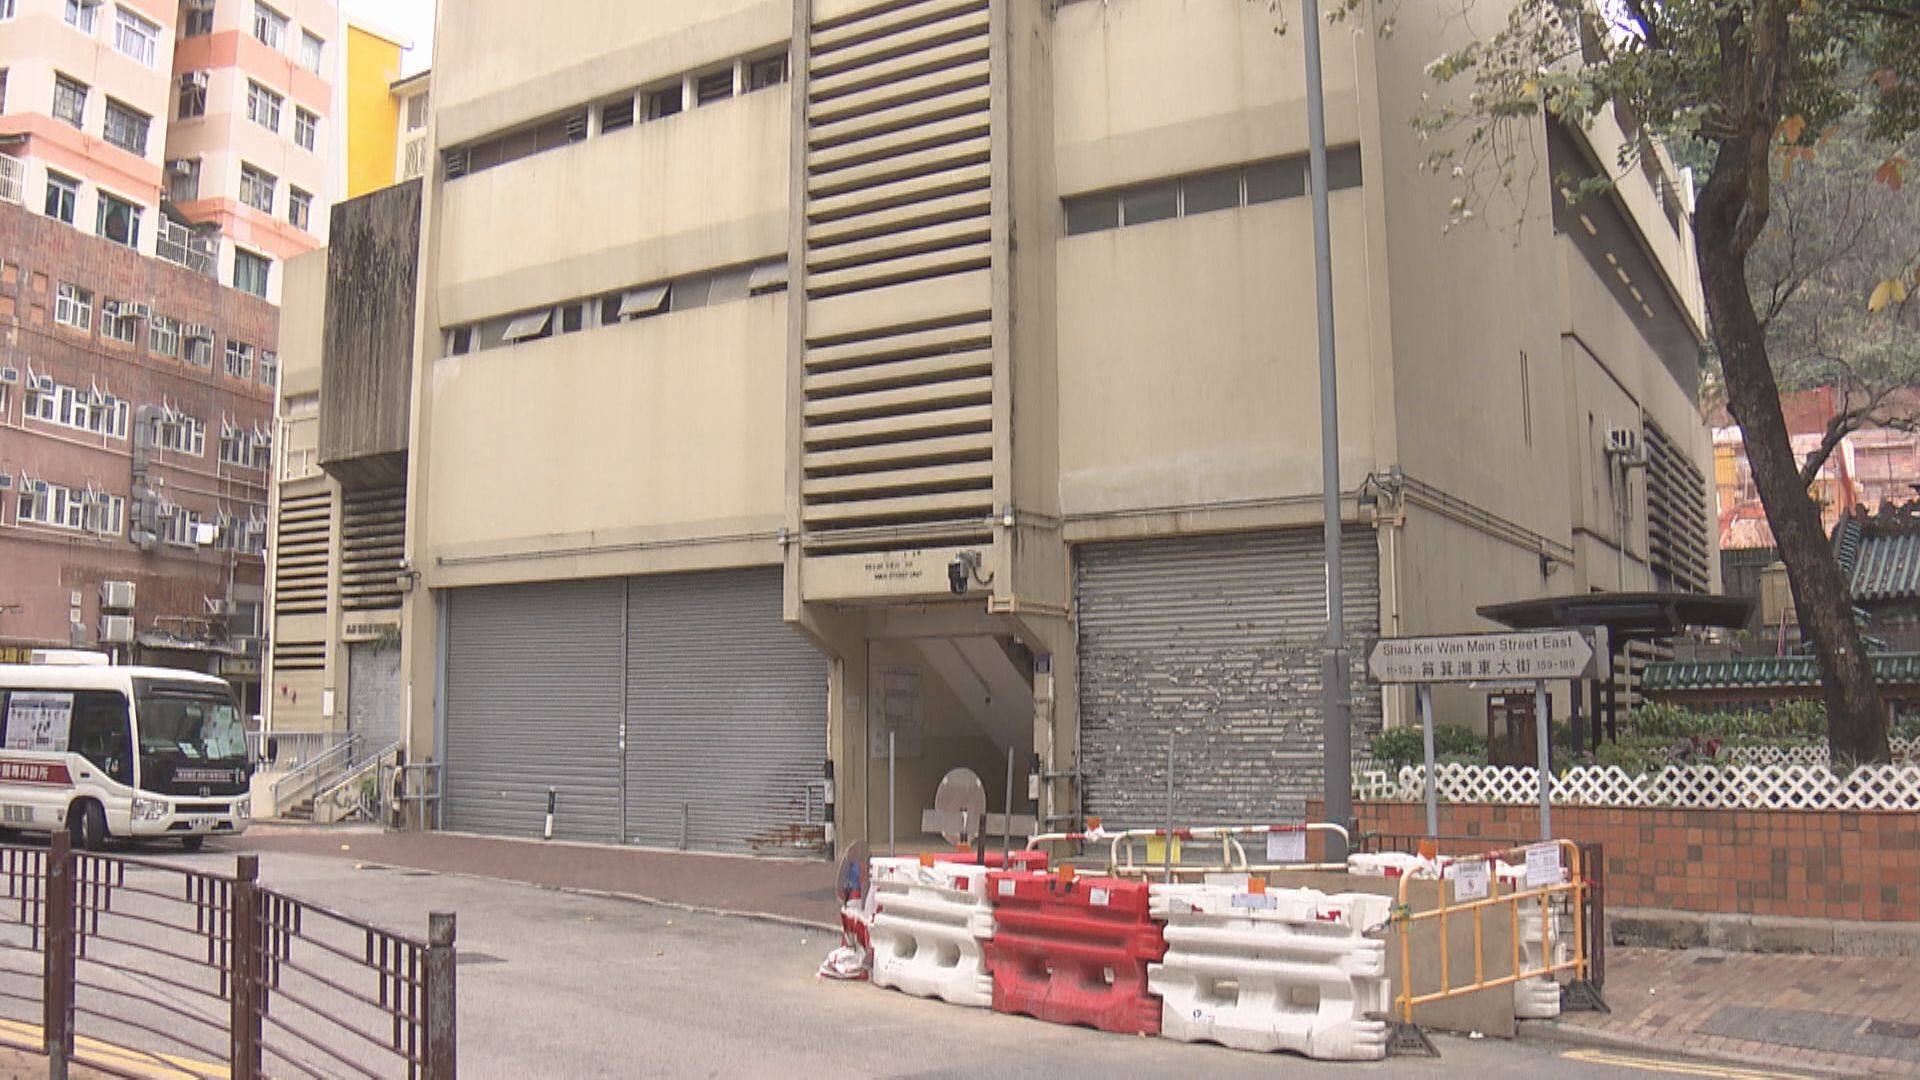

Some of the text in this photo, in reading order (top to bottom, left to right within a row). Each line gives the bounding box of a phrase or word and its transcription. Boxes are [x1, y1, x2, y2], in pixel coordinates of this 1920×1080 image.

[1383, 634, 1572, 656] Shau Kei Wan Main Street East
[1422, 656, 1530, 678] 筲箕灣東大街
